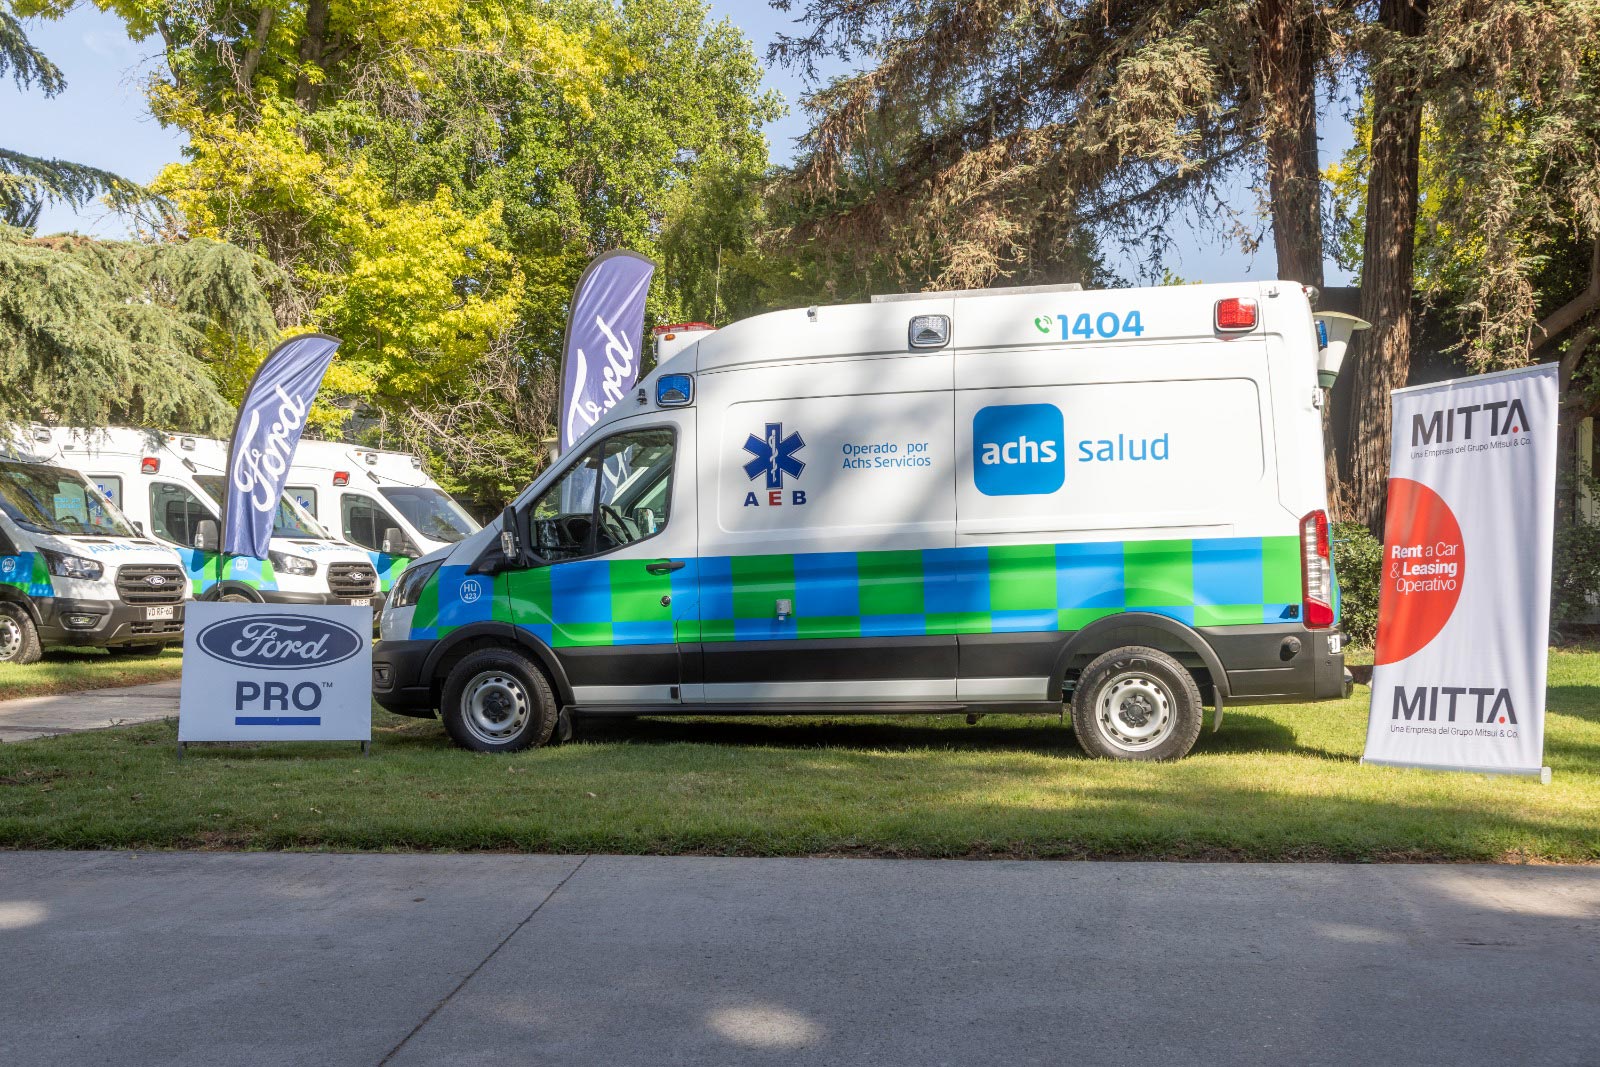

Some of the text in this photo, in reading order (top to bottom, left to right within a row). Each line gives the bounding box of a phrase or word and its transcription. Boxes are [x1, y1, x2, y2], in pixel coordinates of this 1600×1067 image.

[1057, 310, 1145, 340] 1404
[1411, 398, 1531, 447] MITTA
[234, 383, 306, 512] Ford
[842, 442, 929, 458] Operado por
[981, 432, 1170, 466] achs salud
[1410, 450, 1423, 460] Una
[1424, 447, 1454, 458] Empresa
[1455, 444, 1466, 454] del
[1467, 443, 1489, 453] Grupo
[1490, 439, 1513, 450] Mitsui
[1513, 438, 1519, 446] &
[842, 455, 931, 469] Achs Servicios
[1391, 541, 1459, 559] Rent a Car
[1390, 559, 1458, 579] & Leasing
[463, 583, 477, 593] HU
[464, 592, 477, 600] 423
[1396, 576, 1457, 596] Operativo
[231, 622, 331, 660] Ford
[235, 681, 322, 711] PRO
[1391, 685, 1519, 724] MITTA
[1405, 725, 1437, 735] Empresa
[1438, 726, 1450, 735] del
[1450, 727, 1474, 737] Grupo
[1474, 728, 1498, 738] Mitsui
[1499, 730, 1505, 738] &
